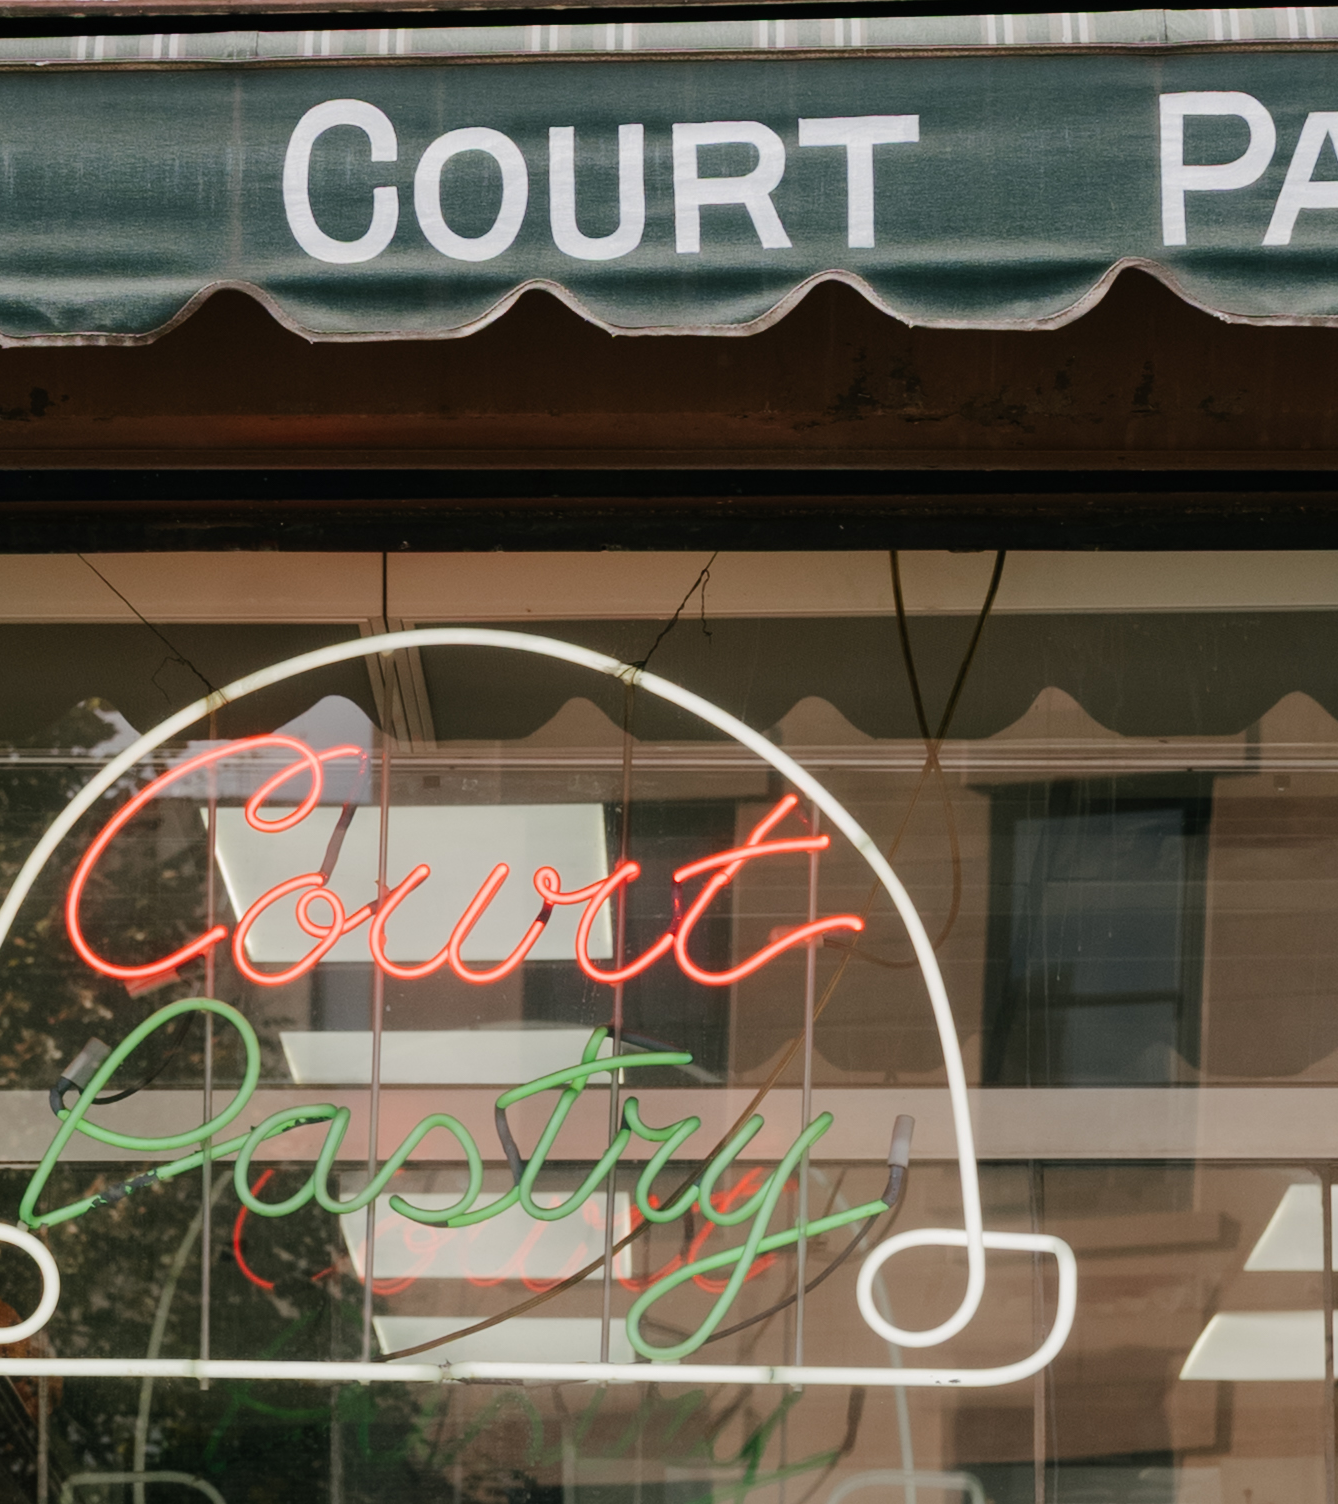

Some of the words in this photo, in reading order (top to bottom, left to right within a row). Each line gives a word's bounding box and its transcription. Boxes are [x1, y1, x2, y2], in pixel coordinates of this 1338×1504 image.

[281, 98, 921, 265] COURT
[66, 733, 865, 988] Court
[18, 996, 890, 1362] Pastry
